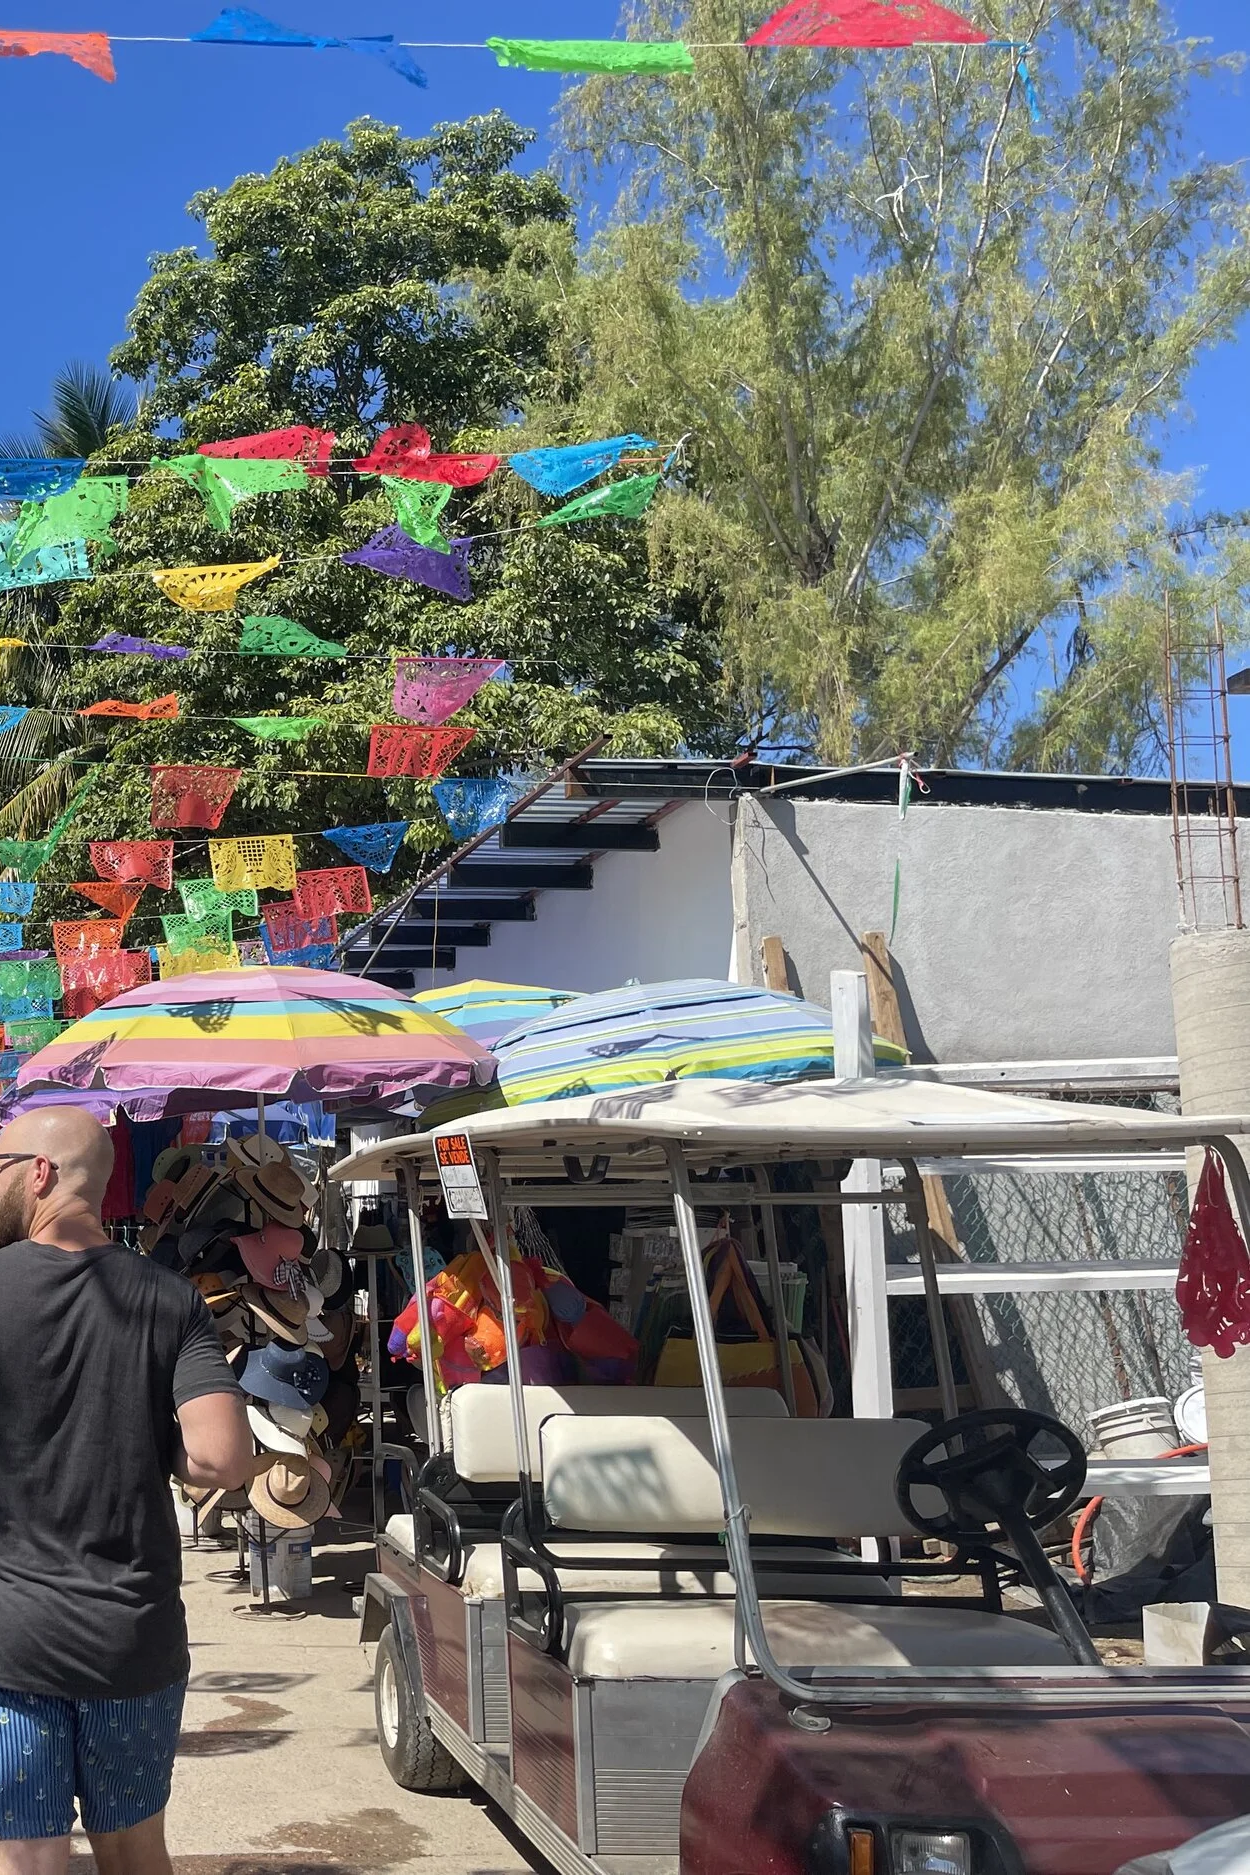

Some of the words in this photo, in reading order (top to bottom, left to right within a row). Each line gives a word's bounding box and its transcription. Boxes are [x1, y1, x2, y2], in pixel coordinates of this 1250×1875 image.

[437, 1138, 450, 1151] FOR
[451, 1136, 467, 1150] SALE
[439, 1152, 449, 1165] SE
[450, 1150, 471, 1164] VENDE
